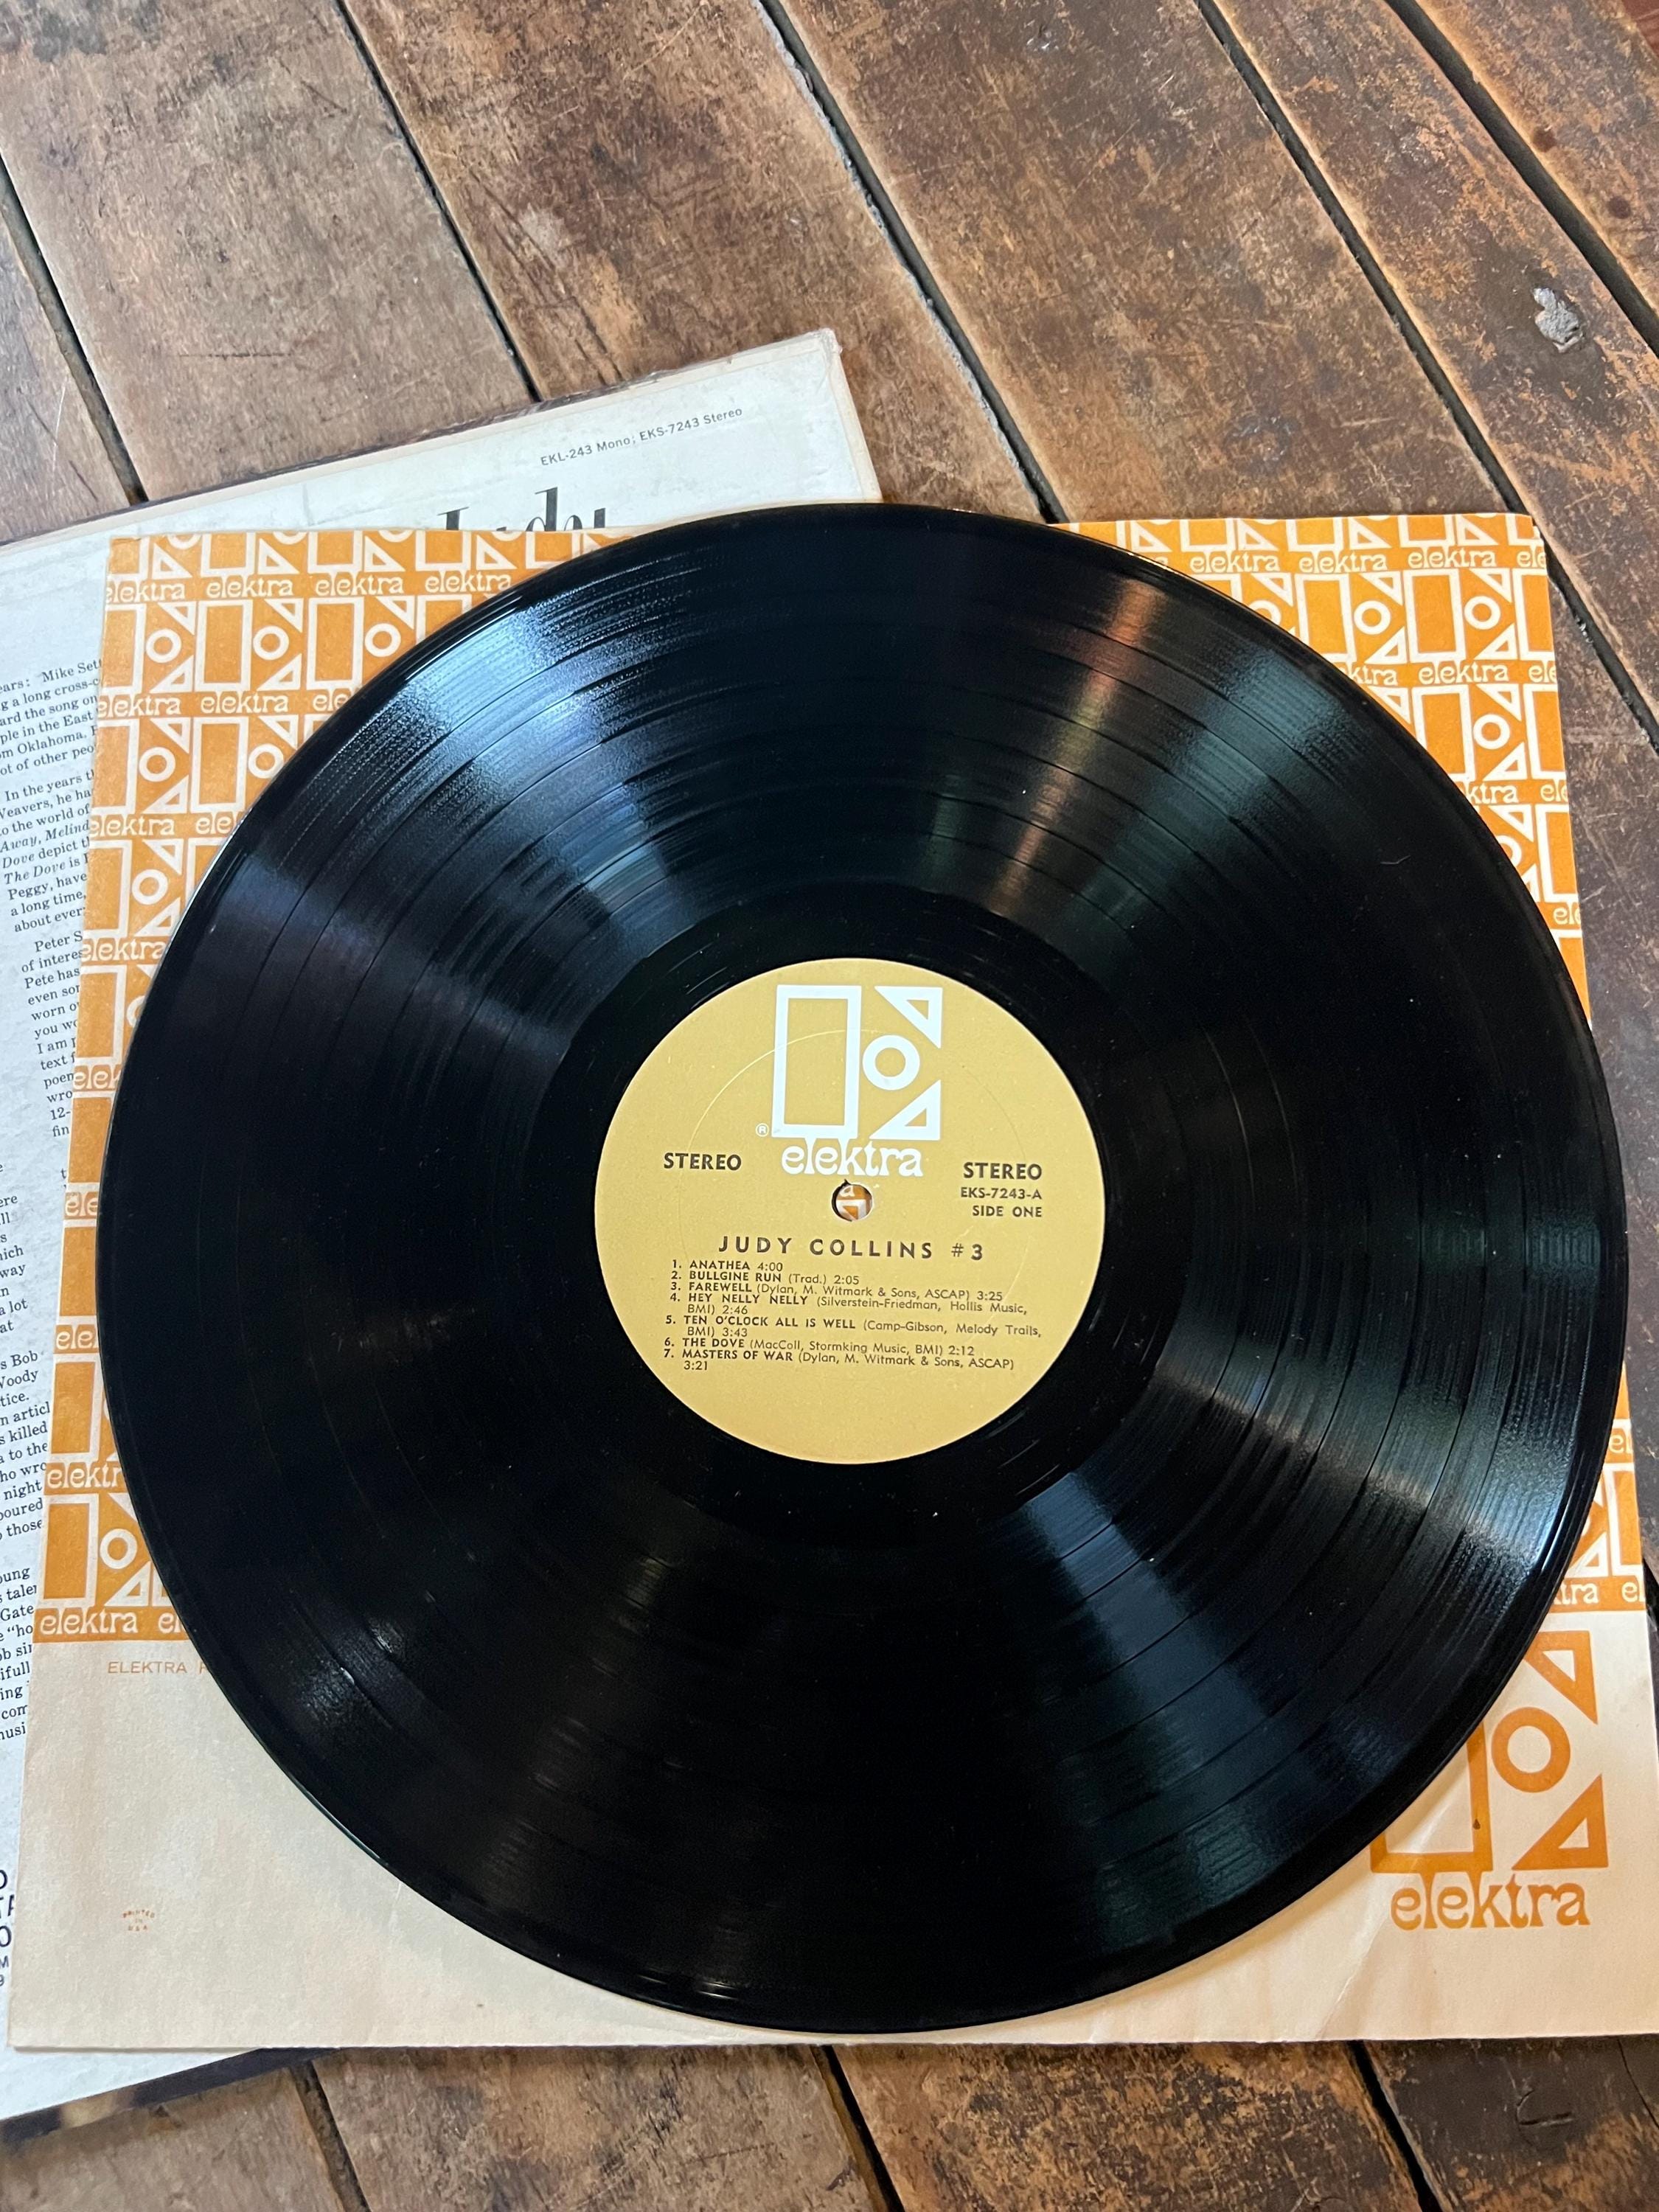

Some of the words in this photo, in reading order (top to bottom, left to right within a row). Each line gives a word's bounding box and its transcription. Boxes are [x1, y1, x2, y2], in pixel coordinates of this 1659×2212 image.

[540, 445, 593, 467] EKL-243
[597, 435, 636, 453] Mono;
[639, 417, 700, 442] EKS-7243
[703, 408, 742, 425] Stereo
[1189, 551, 1280, 573] elektra
[1298, 550, 1388, 573] elektra
[1408, 546, 1497, 568] elektra
[206, 575, 293, 598] elektra
[315, 571, 404, 596] elektra
[425, 570, 511, 593] elektra
[41, 668, 74, 683] Mike
[1418, 661, 1509, 684] elektra
[12, 698, 20, 707] a
[23, 690, 52, 703] long
[54, 678, 100, 696] cross-c
[201, 690, 289, 714] elektra
[0, 712, 21, 726] ard
[24, 708, 46, 720] the
[49, 699, 80, 714] song
[0, 730, 19, 745] ple
[22, 726, 35, 737] in
[38, 721, 60, 733] the
[63, 710, 94, 727] East
[0, 748, 14, 759] om
[17, 731, 88, 754] Oklahoma.
[0, 763, 13, 776] ot
[16, 758, 29, 771] of
[33, 751, 68, 767] other
[72, 744, 96, 759] peo
[4, 790, 20, 802] In
[23, 785, 44, 797] the
[46, 775, 83, 793] years
[56, 794, 72, 805] he
[75, 789, 92, 801] ha
[12, 820, 33, 832] the
[36, 807, 74, 826] world
[77, 803, 90, 816] of
[90, 813, 175, 838] elektra
[0, 835, 41, 853] Away,
[2, 854, 35, 869] Dove
[38, 840, 78, 859] depict
[4, 871, 29, 885] The
[33, 861, 66, 877] Dove
[69, 856, 80, 868] is
[8, 883, 53, 900] Peggy,
[56, 871, 87, 888] have
[10, 908, 18, 916] a
[21, 899, 50, 914] long
[53, 890, 86, 905] time,
[14, 914, 52, 932] about
[55, 906, 86, 922] ever
[34, 935, 70, 953] Peter
[81, 937, 166, 961] elektra
[21, 961, 35, 973] of
[24, 974, 55, 990] Pete
[57, 967, 80, 981] has
[27, 991, 58, 1006] even
[31, 1006, 66, 1021] worn
[34, 1024, 58, 1040] you
[38, 1043, 43, 1054] I
[47, 1039, 68, 1052] am
[41, 1054, 68, 1070] text
[663, 1152, 742, 1171] STEREO
[782, 1138, 924, 1178] elektra
[963, 1161, 1043, 1180] STEREO
[960, 1186, 1043, 1200] EKS-7243-A
[972, 1205, 1004, 1217] SIDE
[1012, 1206, 1043, 1218] ONE
[719, 1236, 793, 1253] JUDY
[809, 1239, 933, 1259] COLLINS
[672, 1259, 681, 1268] 1.
[689, 1260, 750, 1270] ANATHEA
[757, 1262, 783, 1271] 4:00
[671, 1271, 681, 1280] 2.
[689, 1272, 749, 1281] BULLGINE
[755, 1273, 782, 1282] RUN
[788, 1273, 827, 1284] (Trad.)
[834, 1275, 859, 1285] 2:05
[670, 1282, 681, 1290] 3.
[689, 1282, 752, 1292] FAREWELL
[757, 1284, 797, 1295] (Dylan,
[803, 1286, 817, 1295] M.
[823, 1286, 872, 1296] Witmark
[877, 1288, 886, 1296] &
[891, 1288, 920, 1300] Sons,
[925, 1289, 970, 1301] ASCAP)
[977, 1291, 1003, 1301] 3:25
[9, 1298, 28, 1312] lot
[669, 1293, 681, 1302] 4.
[689, 1293, 712, 1302] HEY
[722, 1294, 760, 1304] NELLY
[769, 1295, 808, 1305] NELLY
[817, 1295, 942, 1312] (Silverstein-Friedman,
[950, 1301, 983, 1312] Hollis
[990, 1303, 1027, 1315] Music,
[687, 1304, 715, 1315] BMI)
[723, 1305, 748, 1315] 2:46
[665, 1315, 676, 1324] 5.
[684, 1315, 707, 1325] TEN
[775, 1318, 799, 1327] ALL
[806, 1318, 816, 1327] IS
[823, 1319, 856, 1329] WELL
[863, 1319, 947, 1335] (Camp-Gibson,
[956, 1324, 998, 1336] Melody
[1005, 1325, 1041, 1338] Trails,
[687, 1326, 714, 1338] BMI)
[723, 1327, 748, 1337] 3:43
[664, 1338, 675, 1346] 6.
[682, 1338, 706, 1347] THE
[712, 1338, 745, 1348] DOVE
[750, 1340, 804, 1352] (MacColl,
[809, 1341, 867, 1353] Stormking
[873, 1343, 909, 1355] Music,
[916, 1345, 943, 1356] BMI)
[948, 1346, 975, 1356] 2:12
[10, 1350, 38, 1367] Bob
[664, 1349, 674, 1358] 7.
[682, 1349, 737, 1360] MASTERS
[742, 1351, 759, 1360] OF
[764, 1351, 793, 1361] WAR
[799, 1352, 839, 1364] (Dylan,
[844, 1354, 859, 1363] M.
[864, 1354, 915, 1366] Witmark
[921, 1357, 929, 1366] &
[934, 1357, 963, 1368] Sons,
[968, 1359, 1014, 1370] ASCAP)
[684, 1360, 708, 1371] 3:21
[0, 1393, 29, 1407] tice.
[8, 1421, 48, 1442] killed
[8, 1449, 23, 1461] to
[27, 1442, 48, 1456] the
[0, 1470, 17, 1482] ho
[3, 1480, 43, 1500] night
[6, 1520, 42, 1537] those
[0, 1605, 34, 1621] Gate
[41, 1607, 138, 1635] elektra
[108, 1661, 187, 1674] ELEKTRA
[0, 1686, 23, 1701] ing
[1391, 1868, 1590, 1930] elektra
